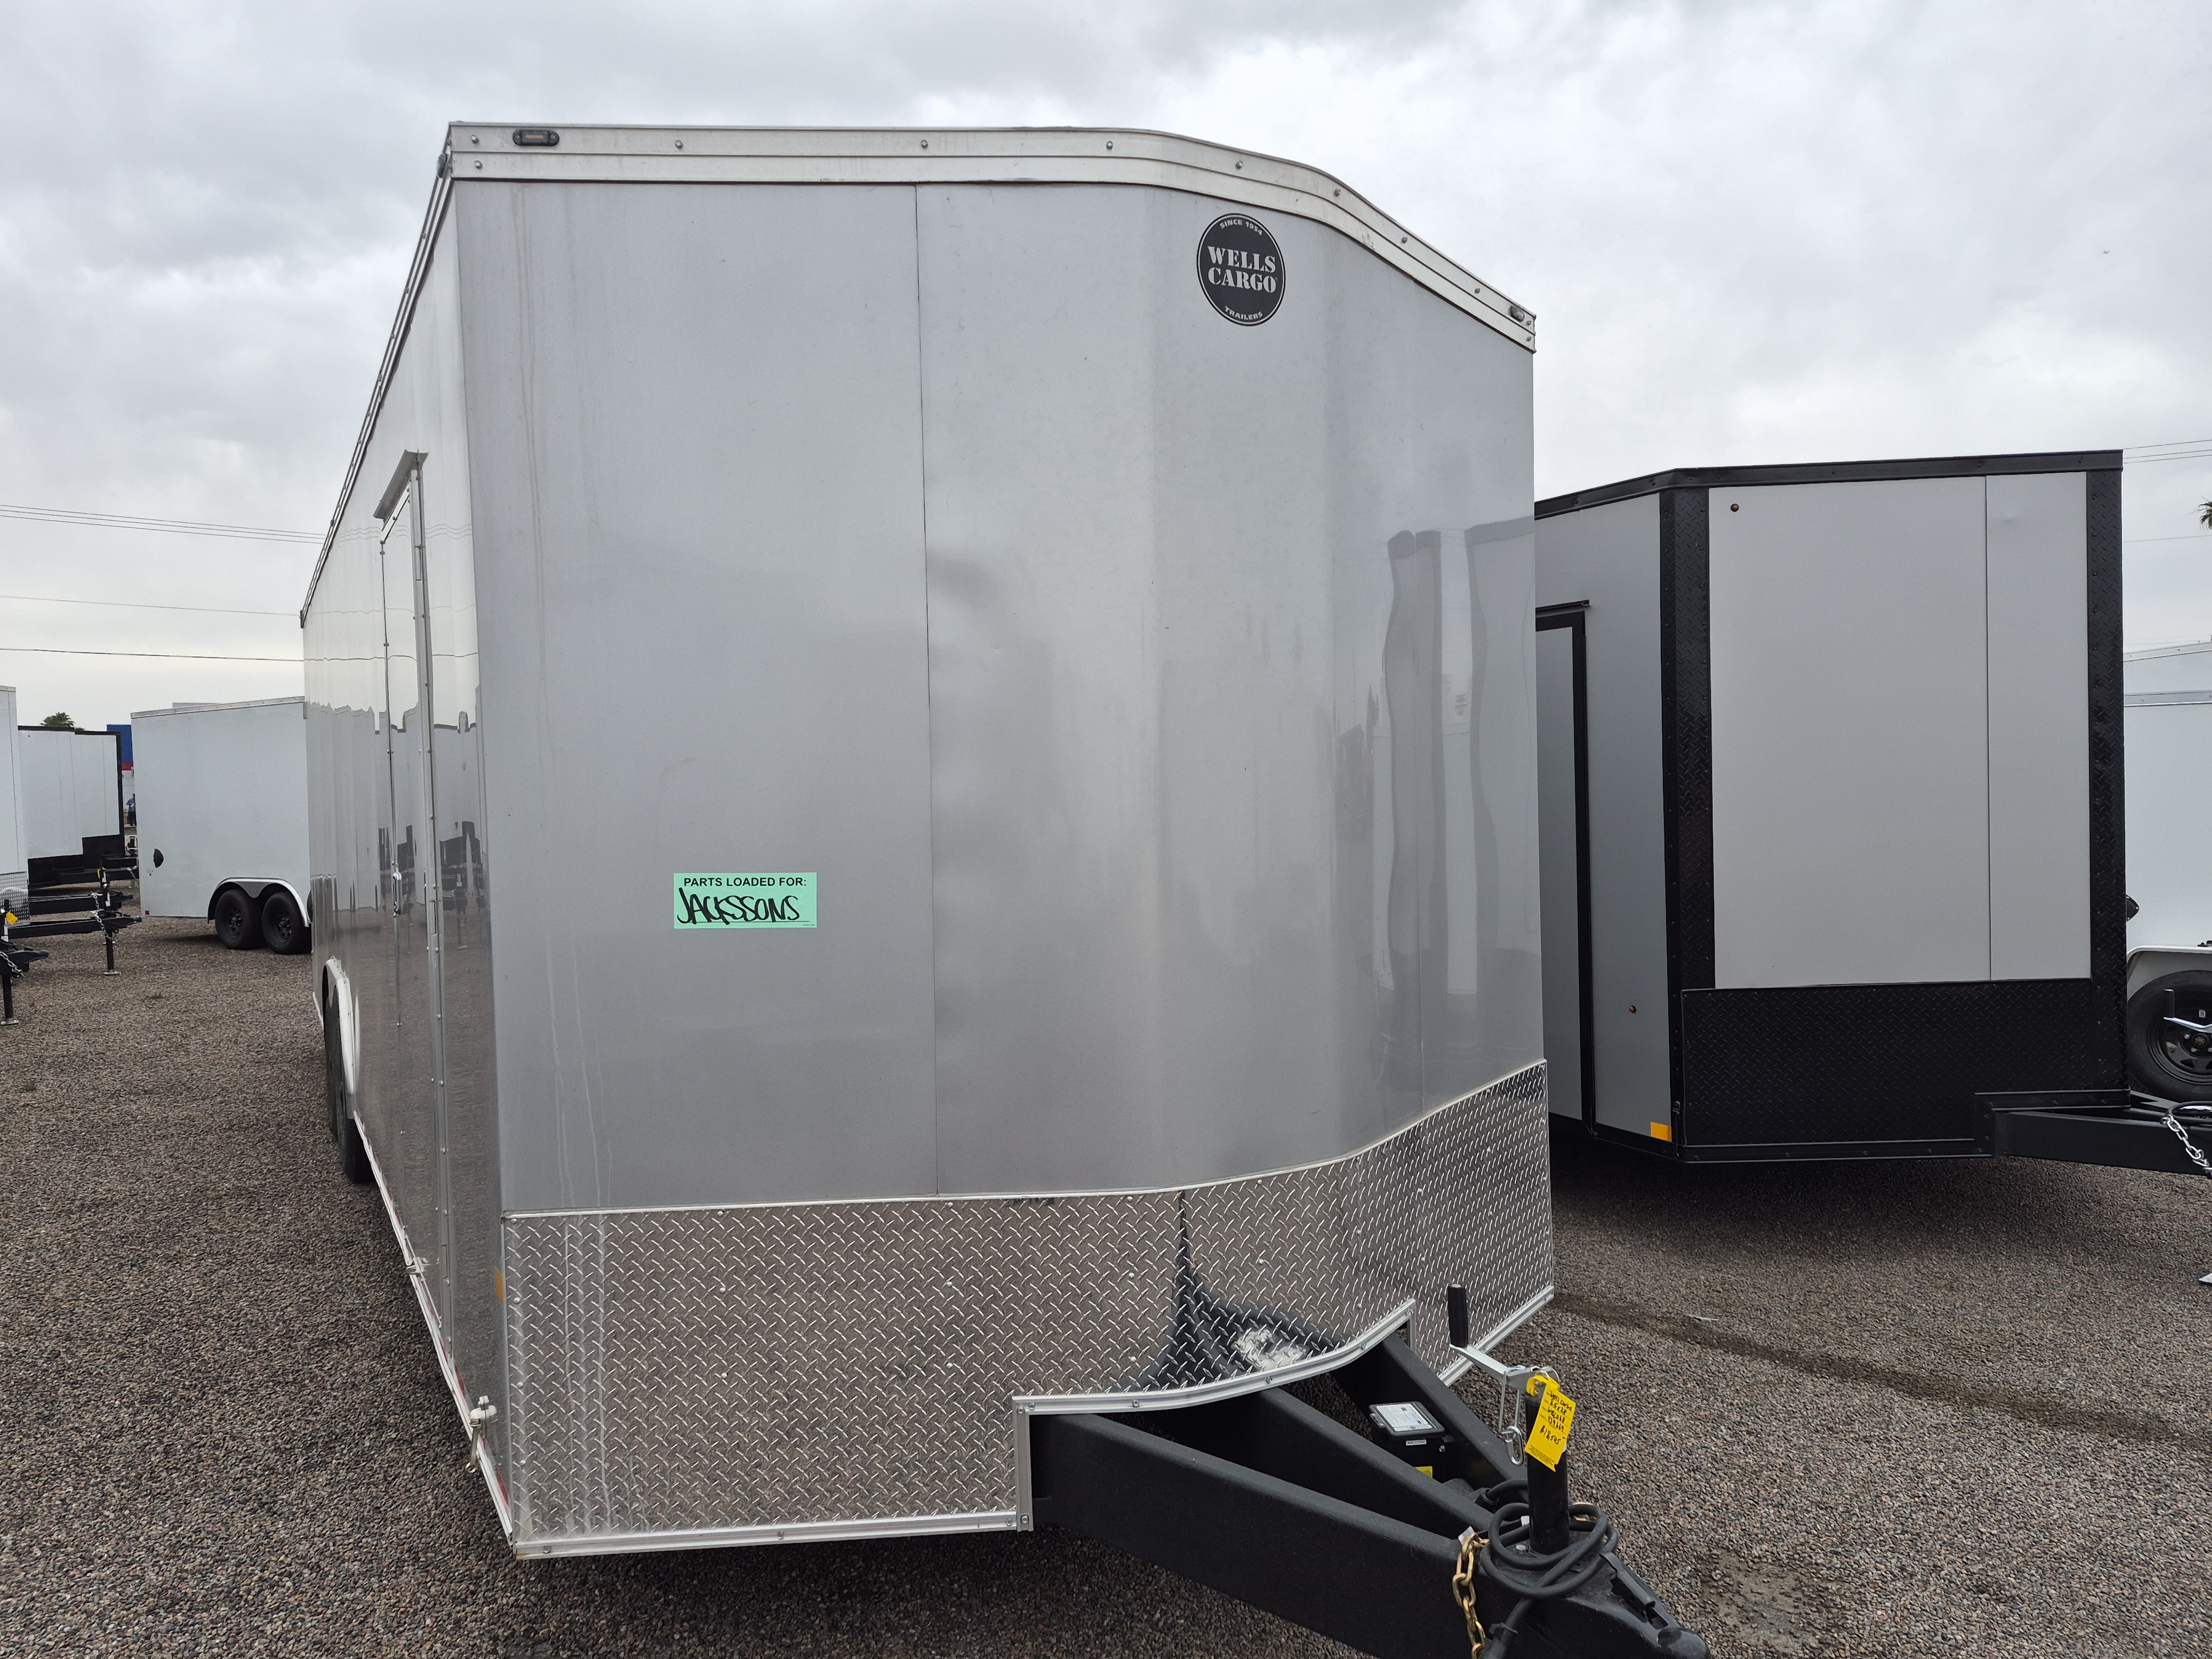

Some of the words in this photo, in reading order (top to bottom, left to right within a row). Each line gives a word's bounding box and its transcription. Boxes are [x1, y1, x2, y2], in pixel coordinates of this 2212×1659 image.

[1219, 219, 1243, 229] SINCE
[1207, 246, 1276, 273] WELLS
[1208, 267, 1276, 293] CARGO
[1224, 305, 1263, 320] TRAILERS
[684, 877, 723, 886] PARTS
[726, 877, 775, 886] LOADED
[779, 877, 807, 886] FOR:
